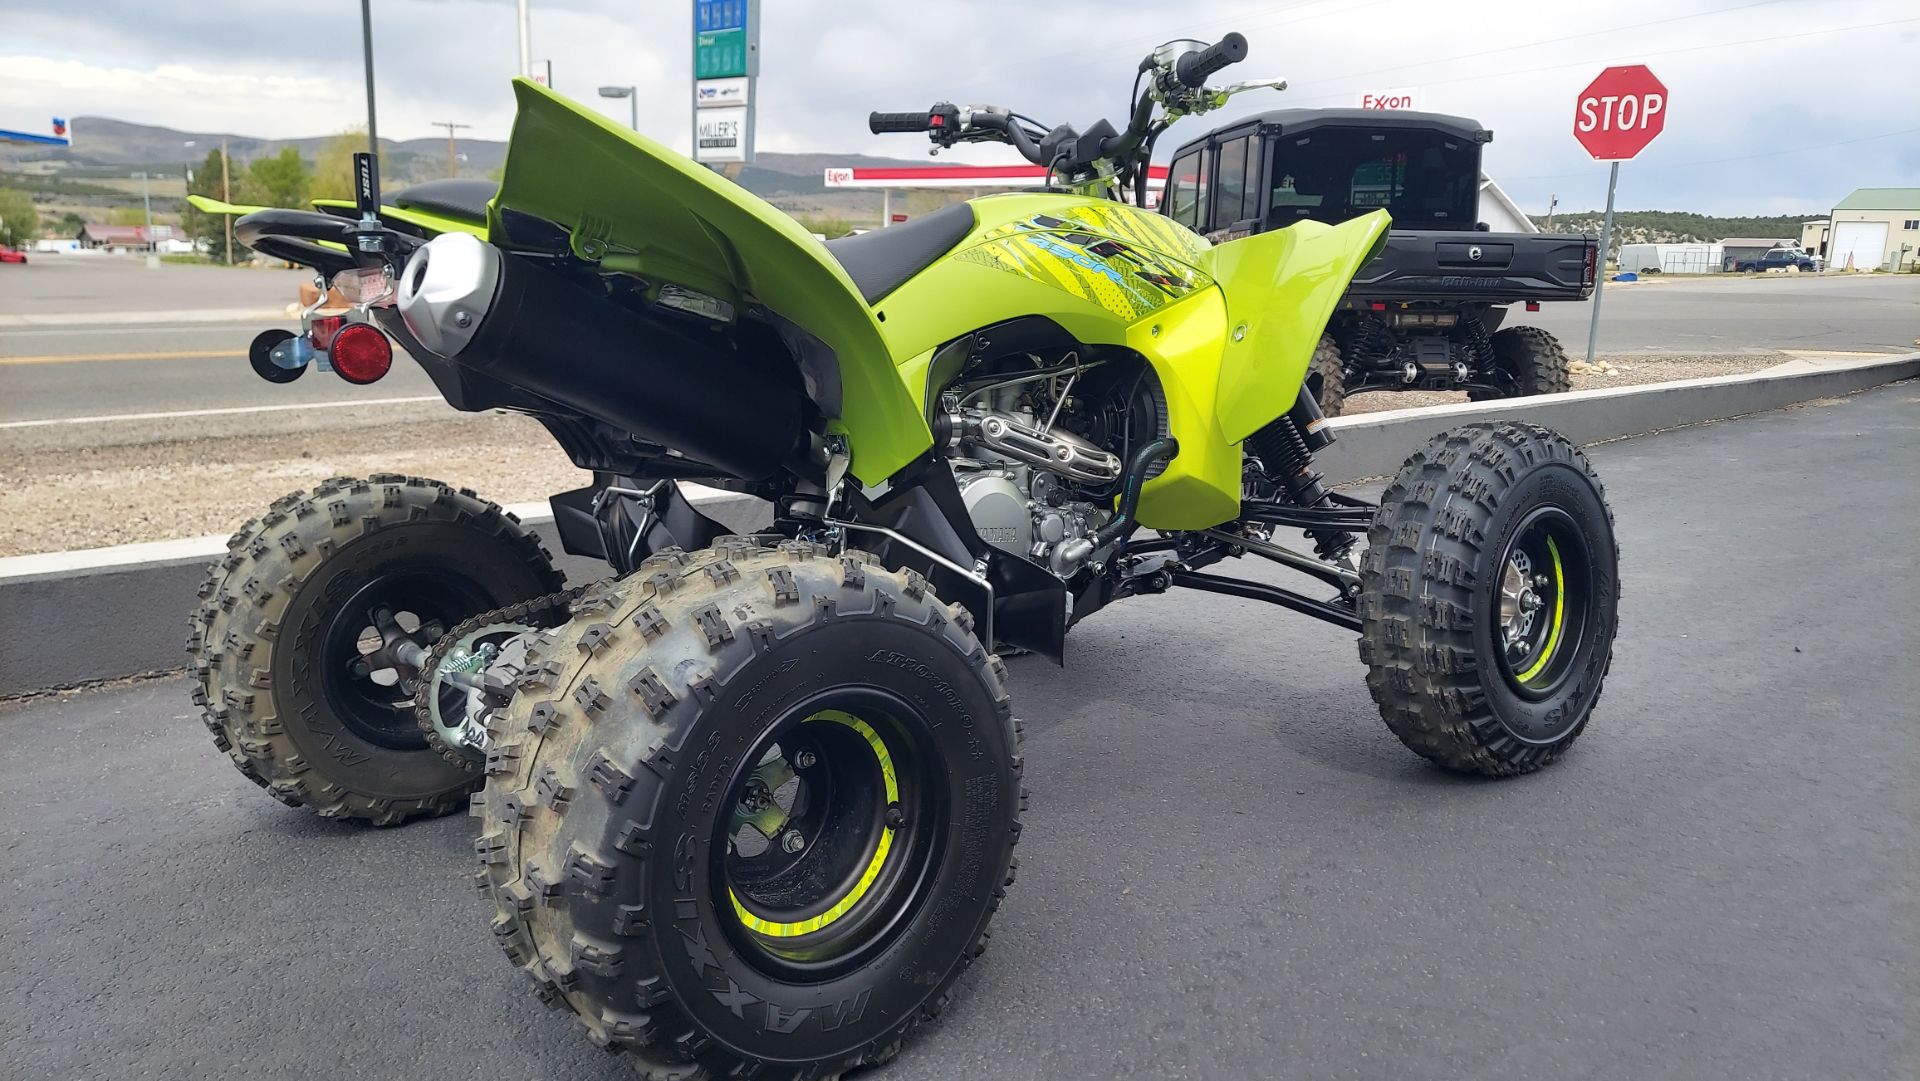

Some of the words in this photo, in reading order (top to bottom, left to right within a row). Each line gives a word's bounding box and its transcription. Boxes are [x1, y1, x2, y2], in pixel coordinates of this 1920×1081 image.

[1363, 94, 1411, 110] Exxon
[1578, 93, 1663, 132] STOP
[699, 121, 738, 138] MILLER'S
[360, 158, 371, 200] TUSK
[828, 170, 849, 185] Exxon
[1026, 238, 1122, 282] 450R
[291, 569, 372, 767] MAXXIS
[1544, 568, 1611, 729] MAXXIS
[673, 832, 873, 1034] MAXXIS
